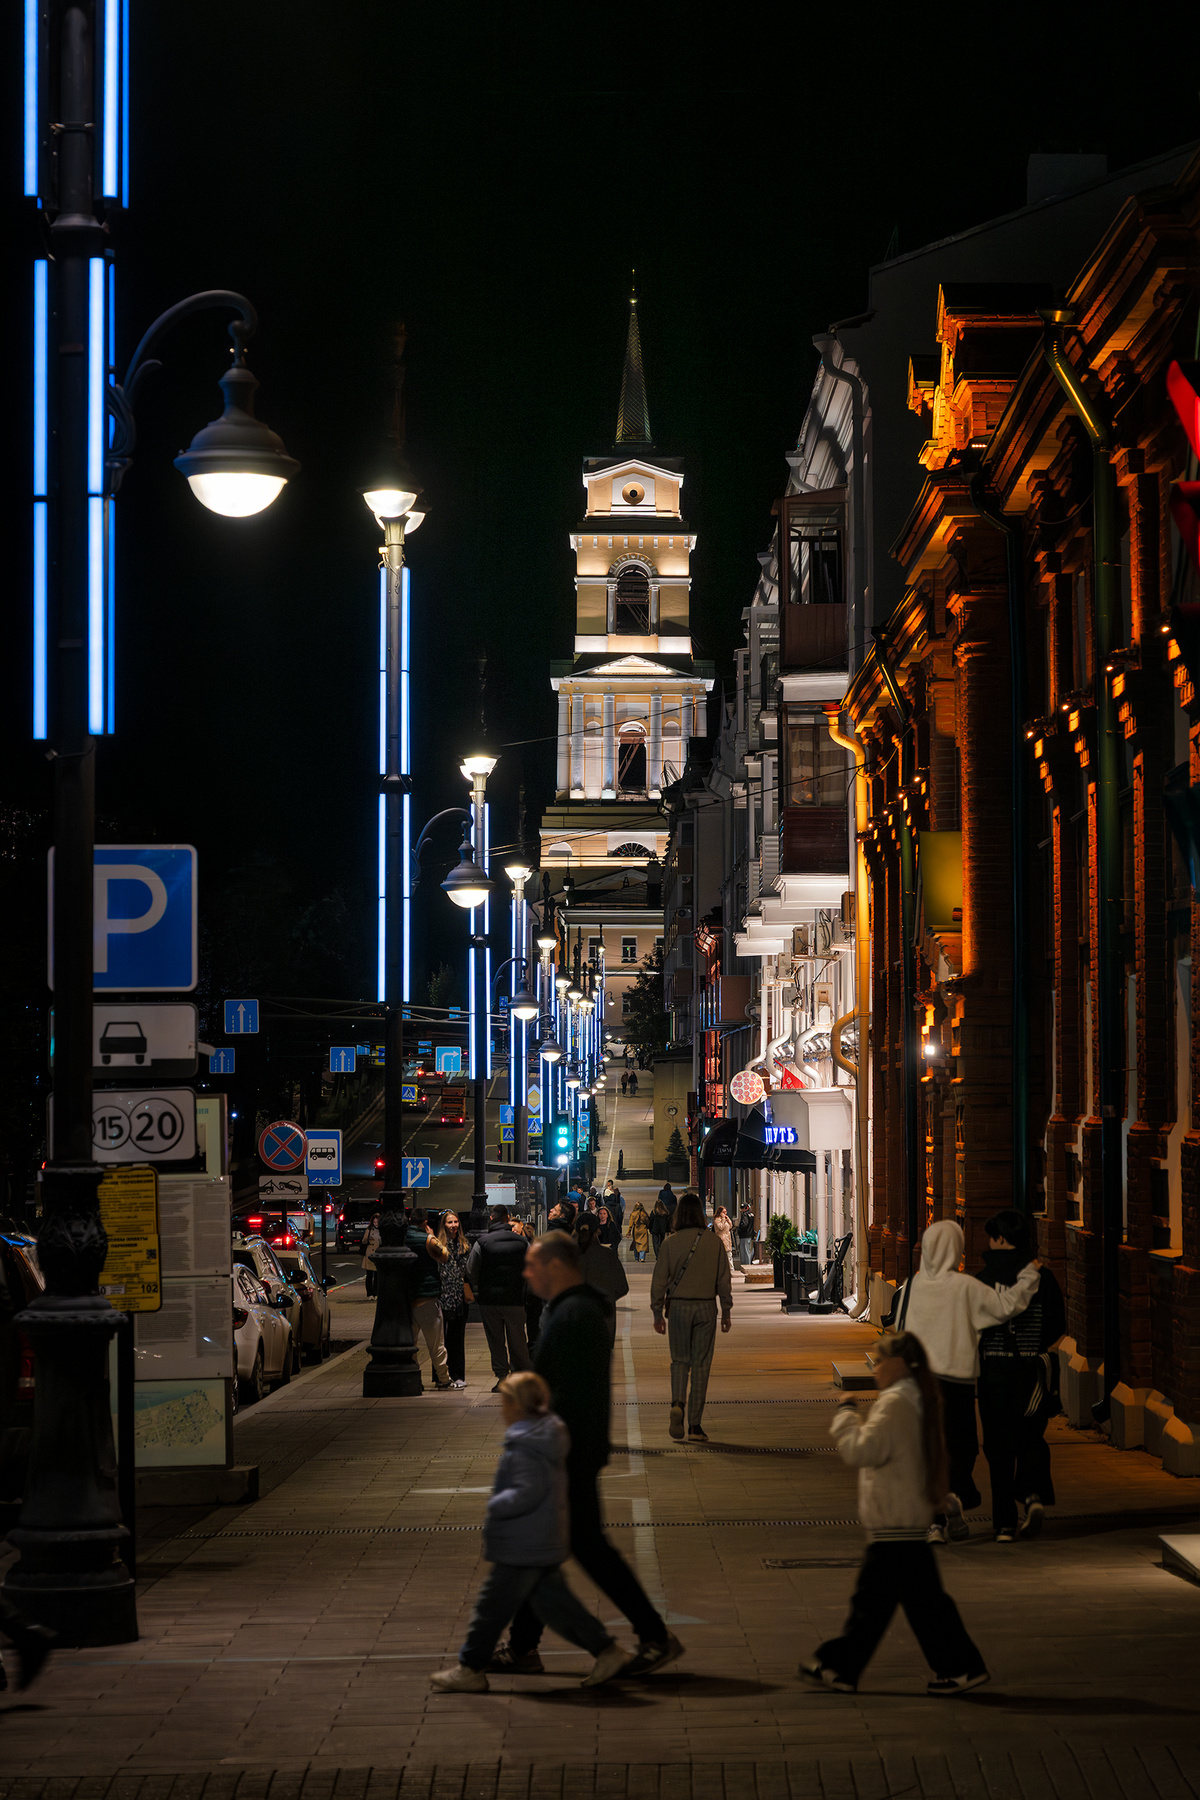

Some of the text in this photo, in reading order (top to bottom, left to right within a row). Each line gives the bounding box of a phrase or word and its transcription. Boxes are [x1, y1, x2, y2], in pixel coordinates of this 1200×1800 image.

[93, 864, 168, 973] P
[97, 1111, 177, 1142] 15 20
[141, 1284, 159, 1294] 102
